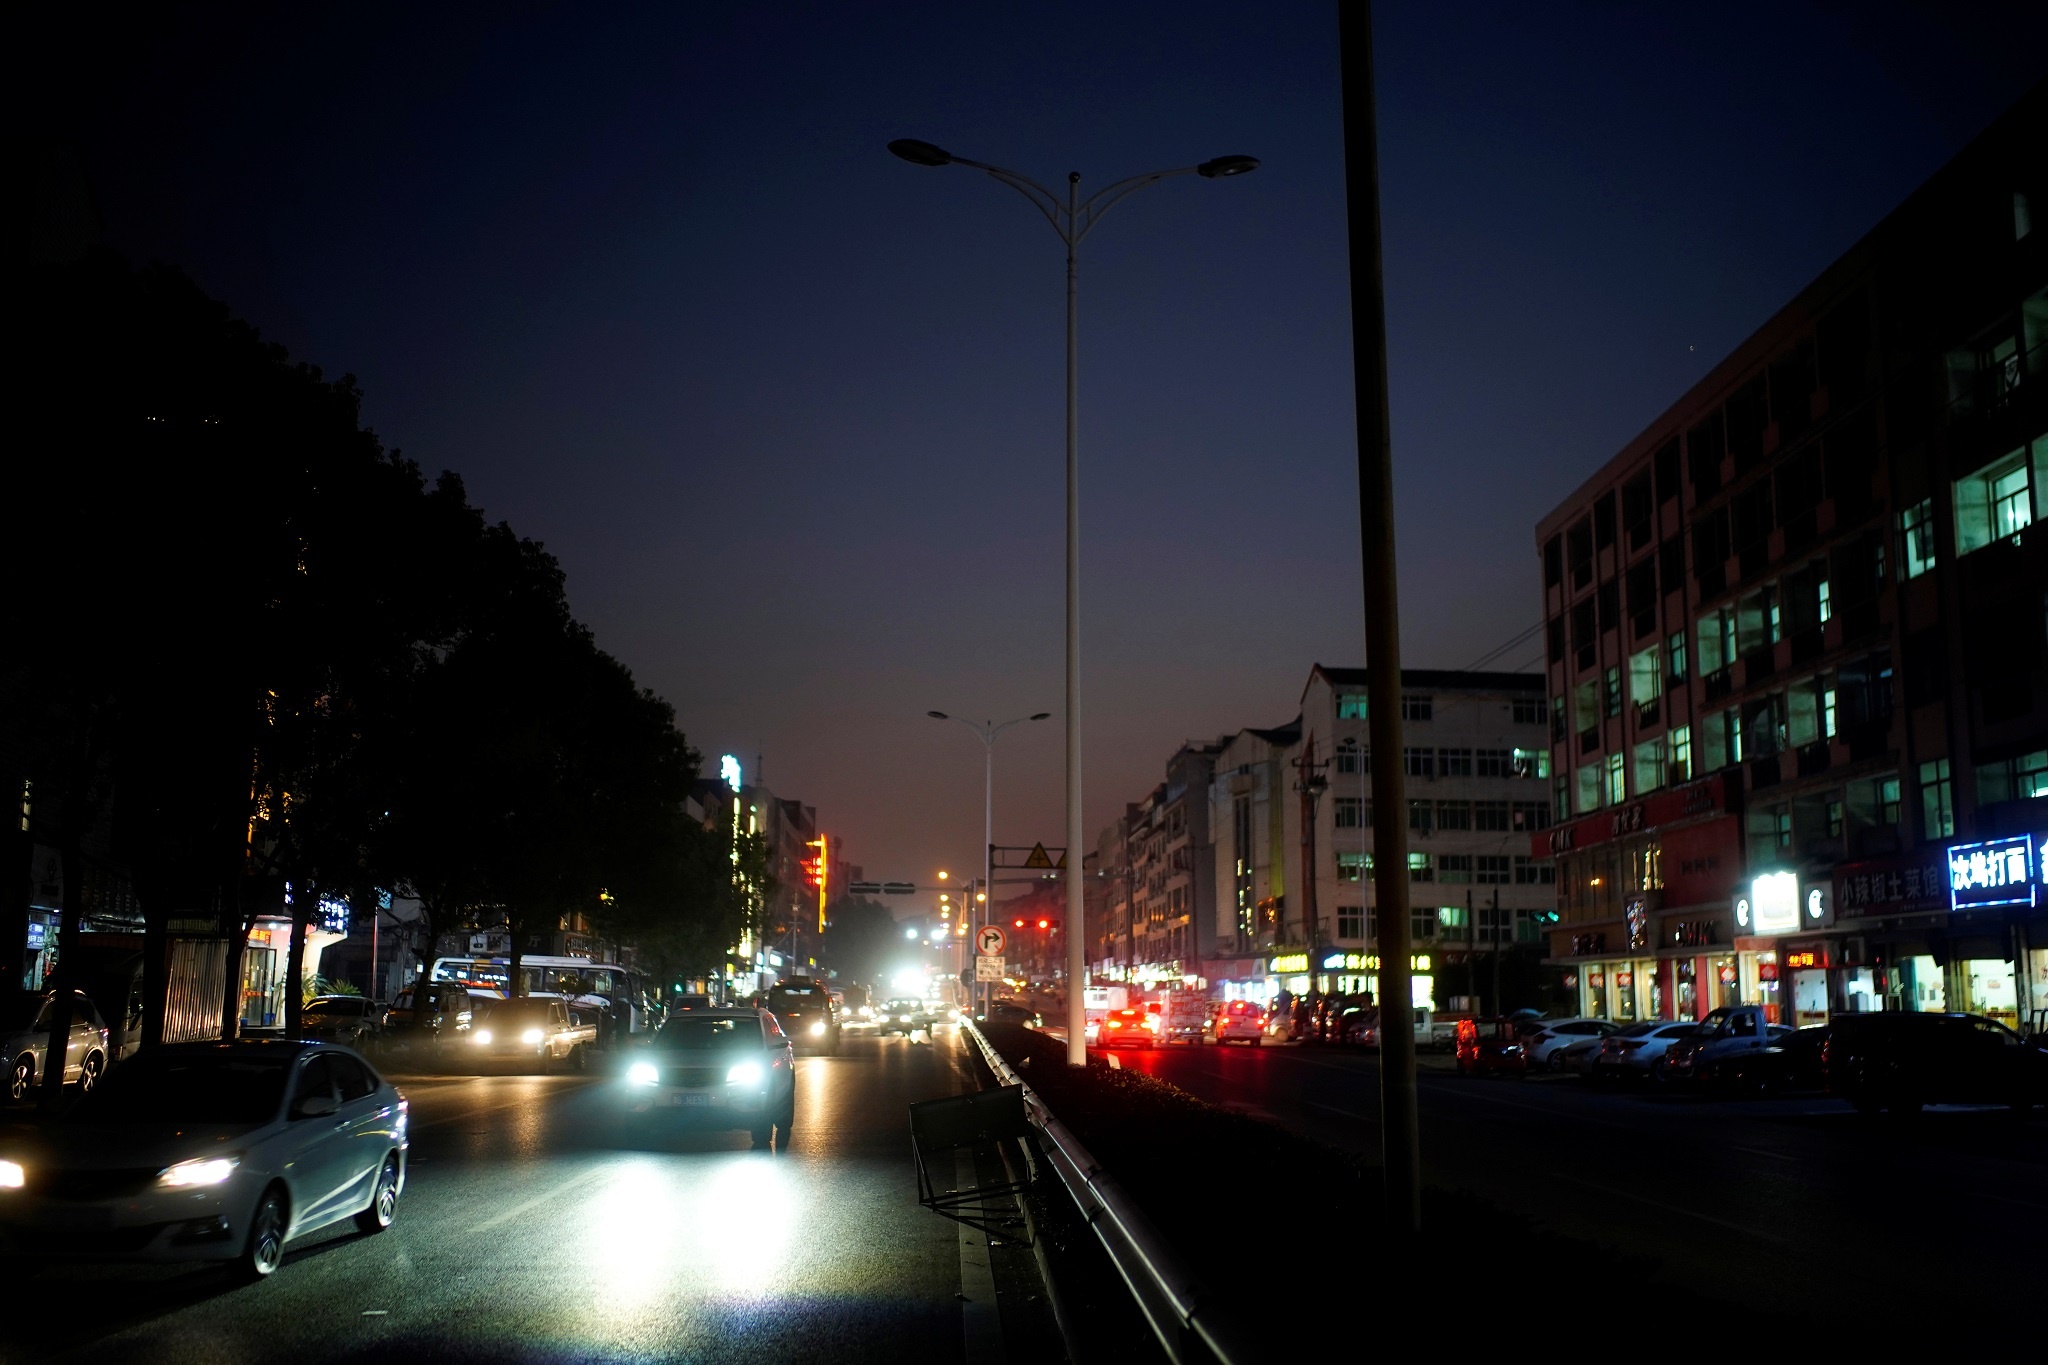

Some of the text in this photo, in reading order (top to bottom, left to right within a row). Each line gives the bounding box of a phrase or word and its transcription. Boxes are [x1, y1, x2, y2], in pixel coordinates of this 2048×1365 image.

[1840, 863, 1940, 907] 小辣椒土菜馆
